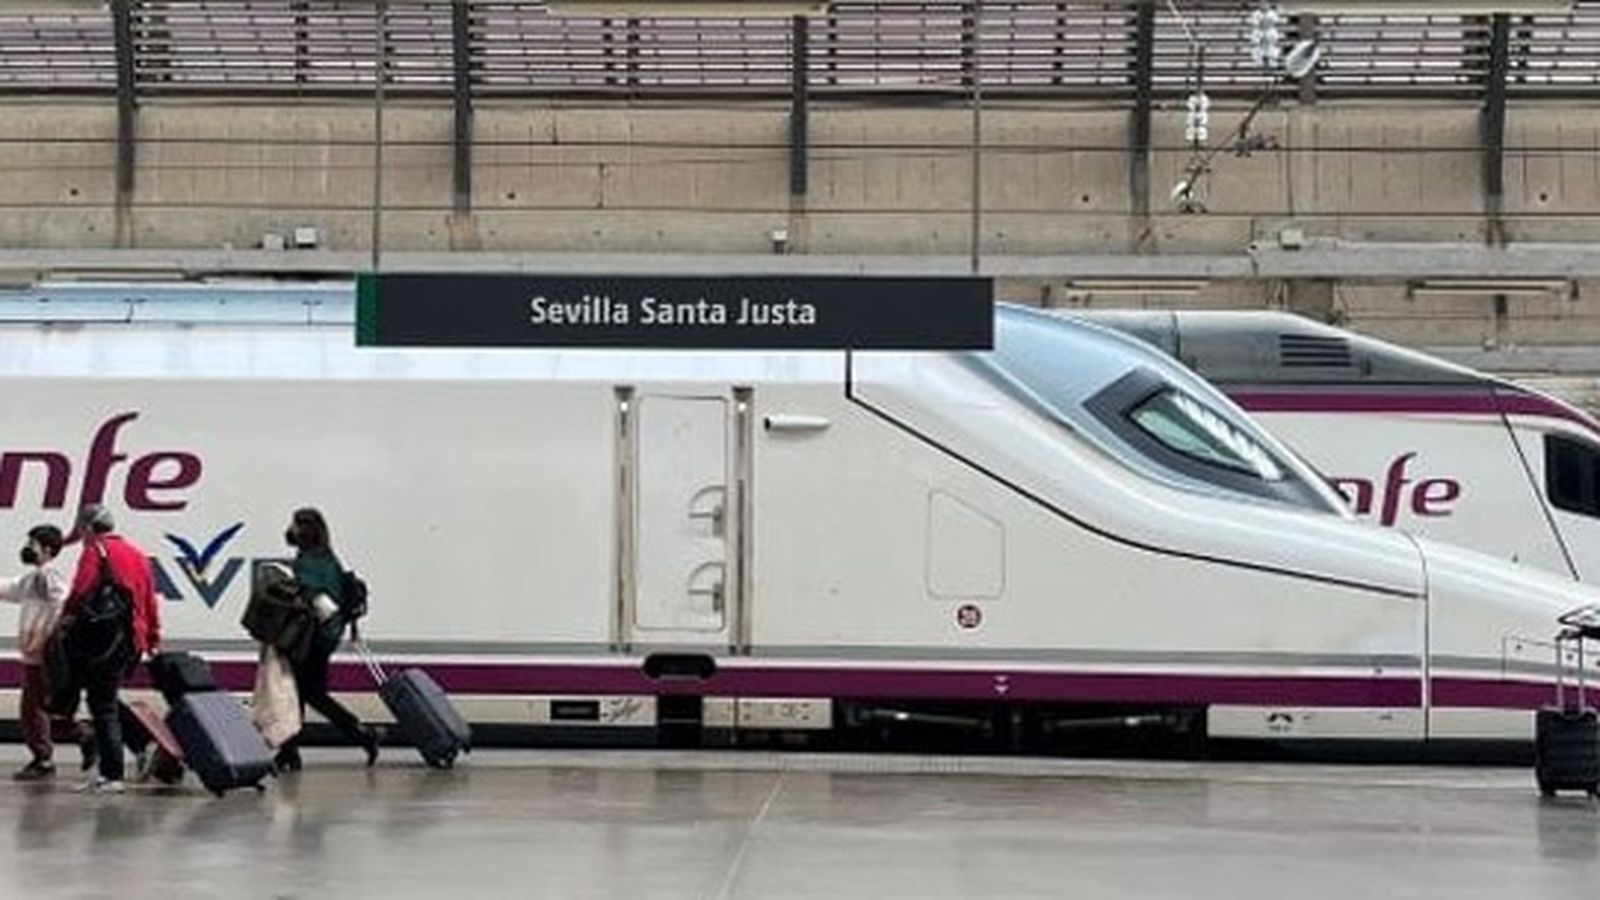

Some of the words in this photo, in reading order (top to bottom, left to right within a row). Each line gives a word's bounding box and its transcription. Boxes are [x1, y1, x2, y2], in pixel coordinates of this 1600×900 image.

[531, 295, 629, 324] Sevilla
[640, 297, 727, 324] Santa
[736, 298, 817, 325] Justa
